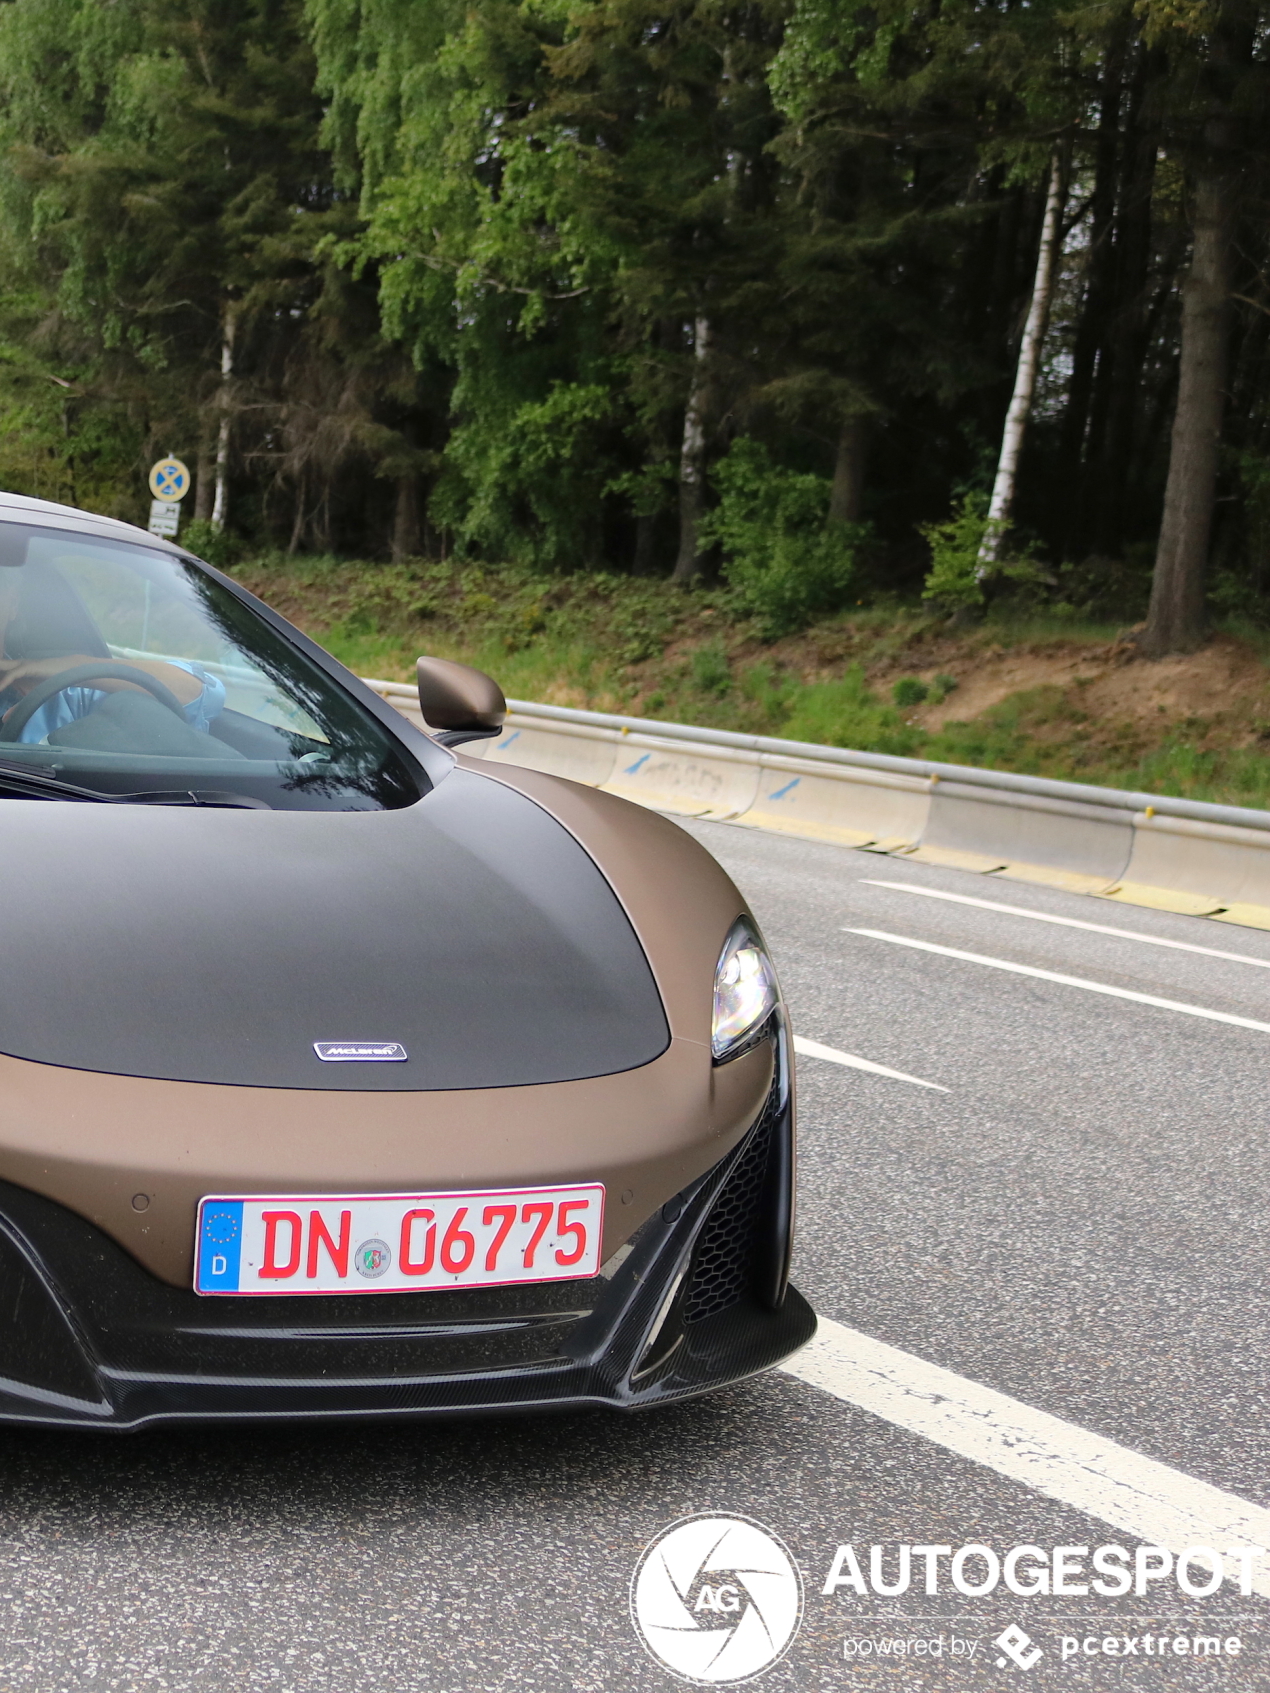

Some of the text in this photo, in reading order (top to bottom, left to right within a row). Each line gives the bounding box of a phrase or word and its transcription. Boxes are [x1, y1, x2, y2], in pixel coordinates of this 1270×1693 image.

[258, 1199, 590, 1279] DN 06775
[212, 1255, 227, 1275] D
